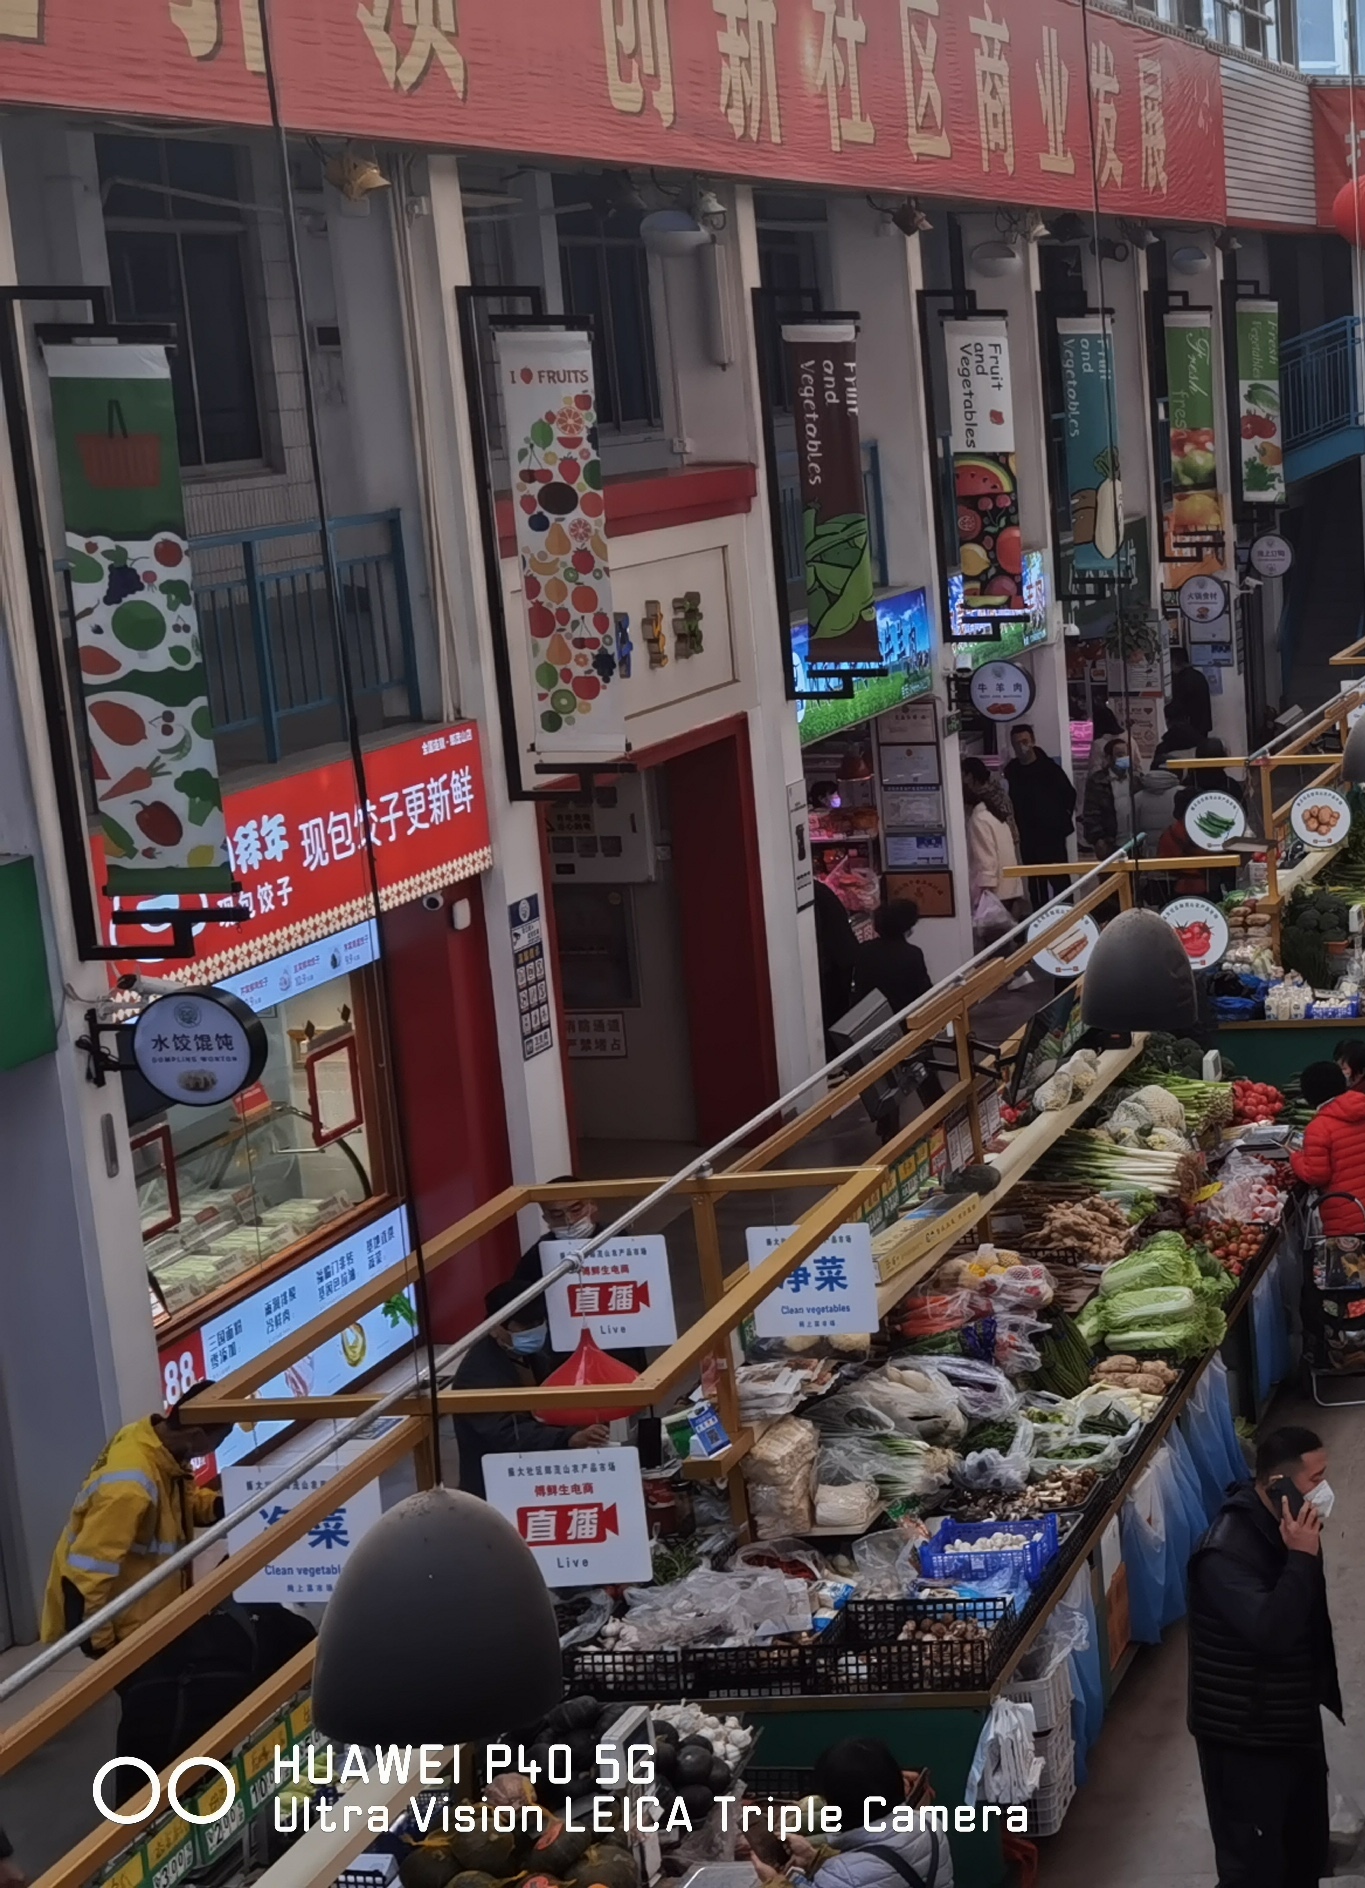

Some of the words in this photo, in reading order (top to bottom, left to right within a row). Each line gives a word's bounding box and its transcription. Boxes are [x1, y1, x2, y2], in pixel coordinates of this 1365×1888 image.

[973, 342, 989, 377] and
[986, 343, 1004, 392] Fruit
[1079, 337, 1096, 375] and
[509, 369, 517, 384] I
[537, 366, 589, 385] FRUITS
[822, 359, 840, 408] and
[1061, 337, 1081, 438] Vegetables
[958, 342, 978, 449] Vegetables
[799, 360, 823, 486] Vegetables
[977, 682, 1023, 693] 牛羊肉
[299, 766, 475, 872] 现包饺子更新鲜
[151, 1033, 235, 1053] 水饺馄饨
[574, 1284, 635, 1314] 直播
[780, 1305, 805, 1316] Clean
[806, 1304, 851, 1316] vegetables
[600, 1324, 627, 1335] Live
[525, 1507, 600, 1542] 直播
[264, 1564, 294, 1576] Clean
[296, 1564, 341, 1577] vegetabl
[556, 1557, 590, 1569] Live
